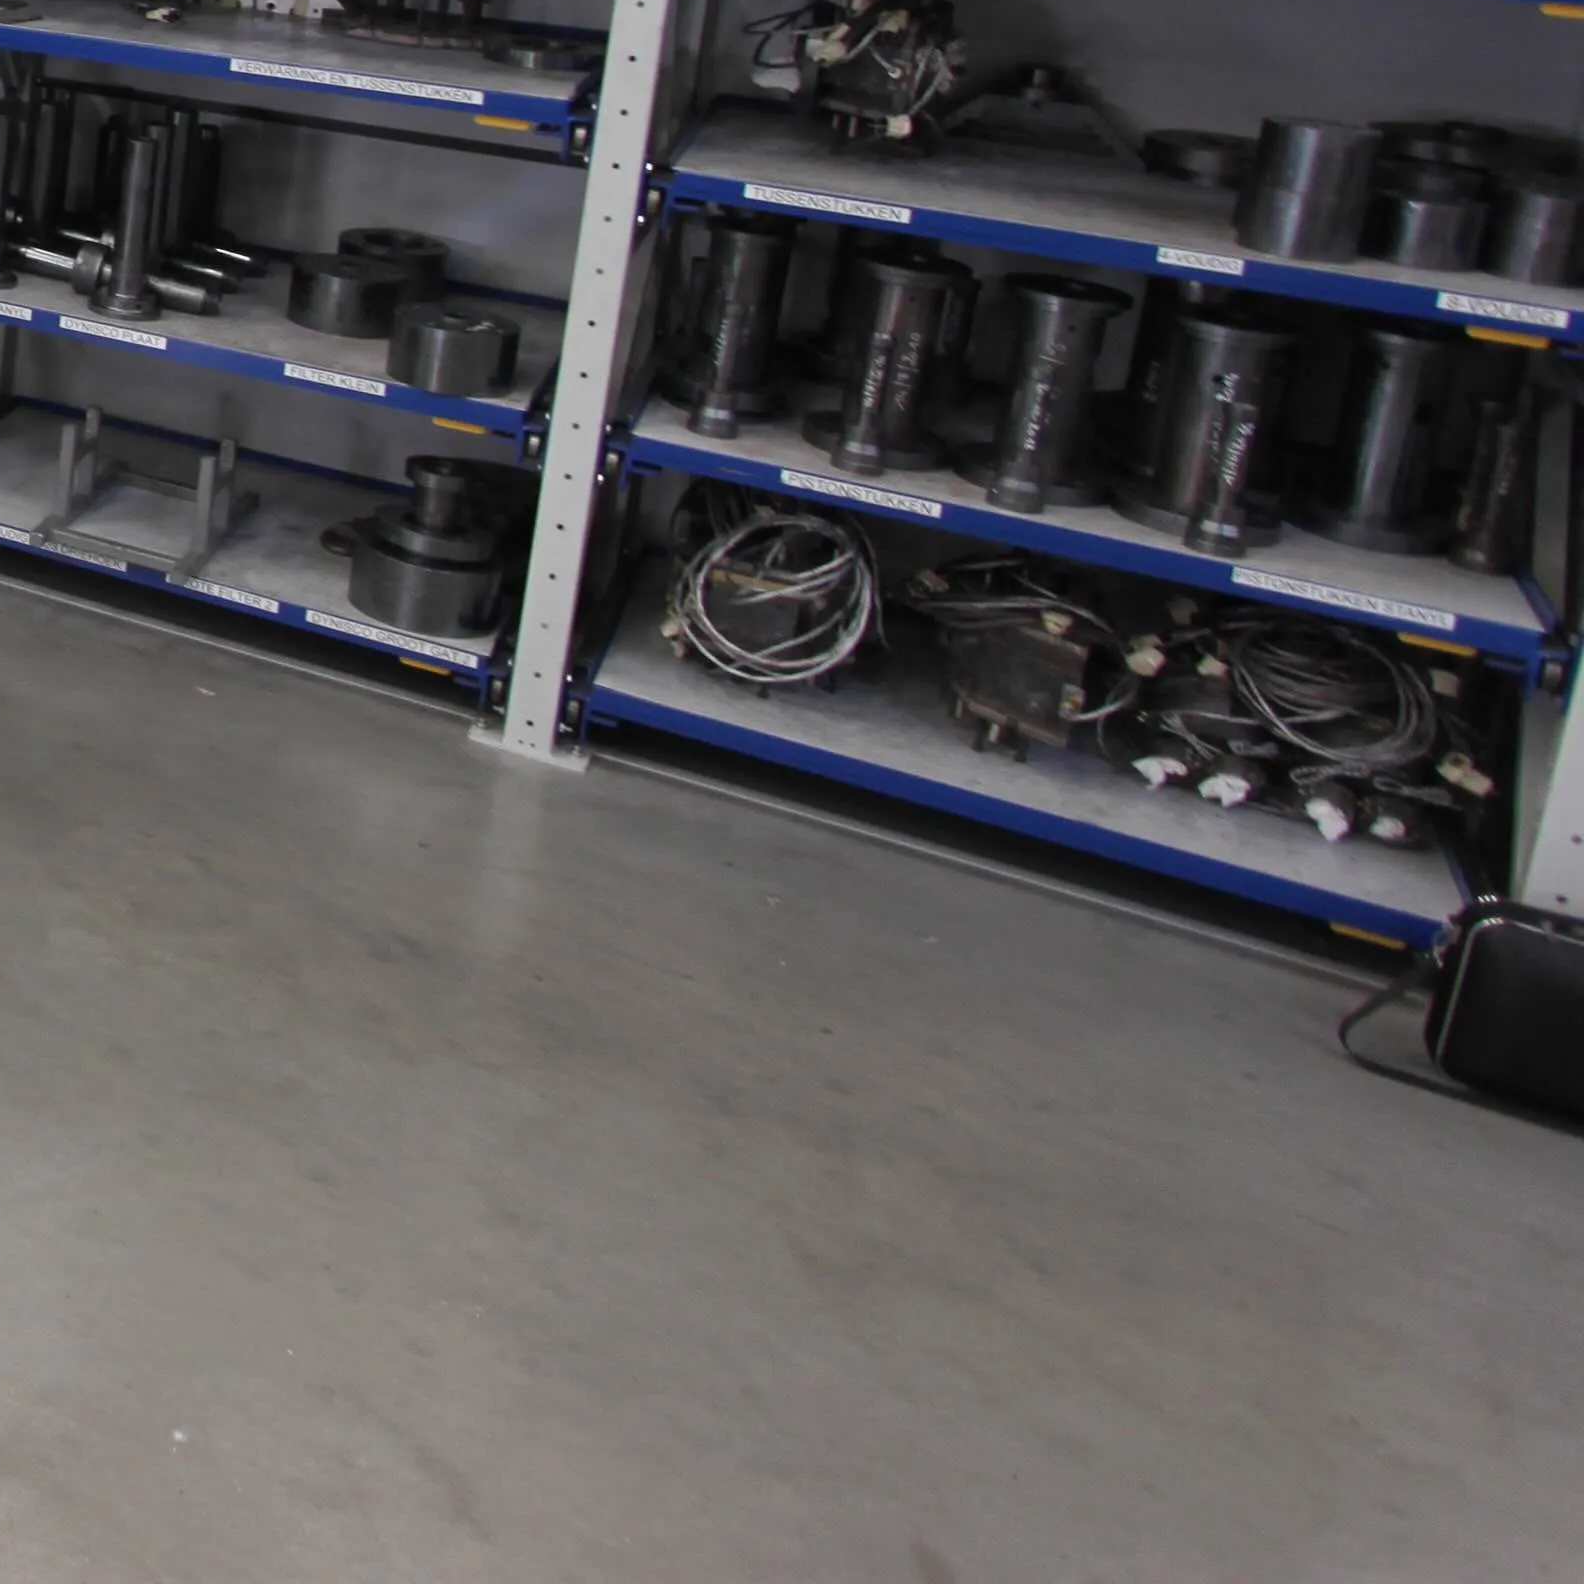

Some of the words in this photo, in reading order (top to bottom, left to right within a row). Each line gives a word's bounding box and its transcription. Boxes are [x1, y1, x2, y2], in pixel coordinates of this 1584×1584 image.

[236, 61, 328, 83] VERWARMING
[329, 74, 348, 85] EN
[352, 76, 474, 102] TUSSENSTUKKEN
[751, 185, 903, 221] TUSSENSTUKKEN
[64, 318, 119, 337] DYNISCO
[121, 332, 162, 347] PLAAT
[289, 365, 337, 384] FILTER
[339, 375, 380, 394] KLEIN
[786, 471, 934, 515] PISTONSTUKKEN
[216, 586, 262, 607] FILTER
[1232, 567, 1380, 612] PISTONSTUKKEN
[1382, 599, 1448, 627] STANYL
[311, 612, 373, 638] DYNISCO
[375, 629, 426, 652] GROOT
[430, 643, 460, 662] GAT
